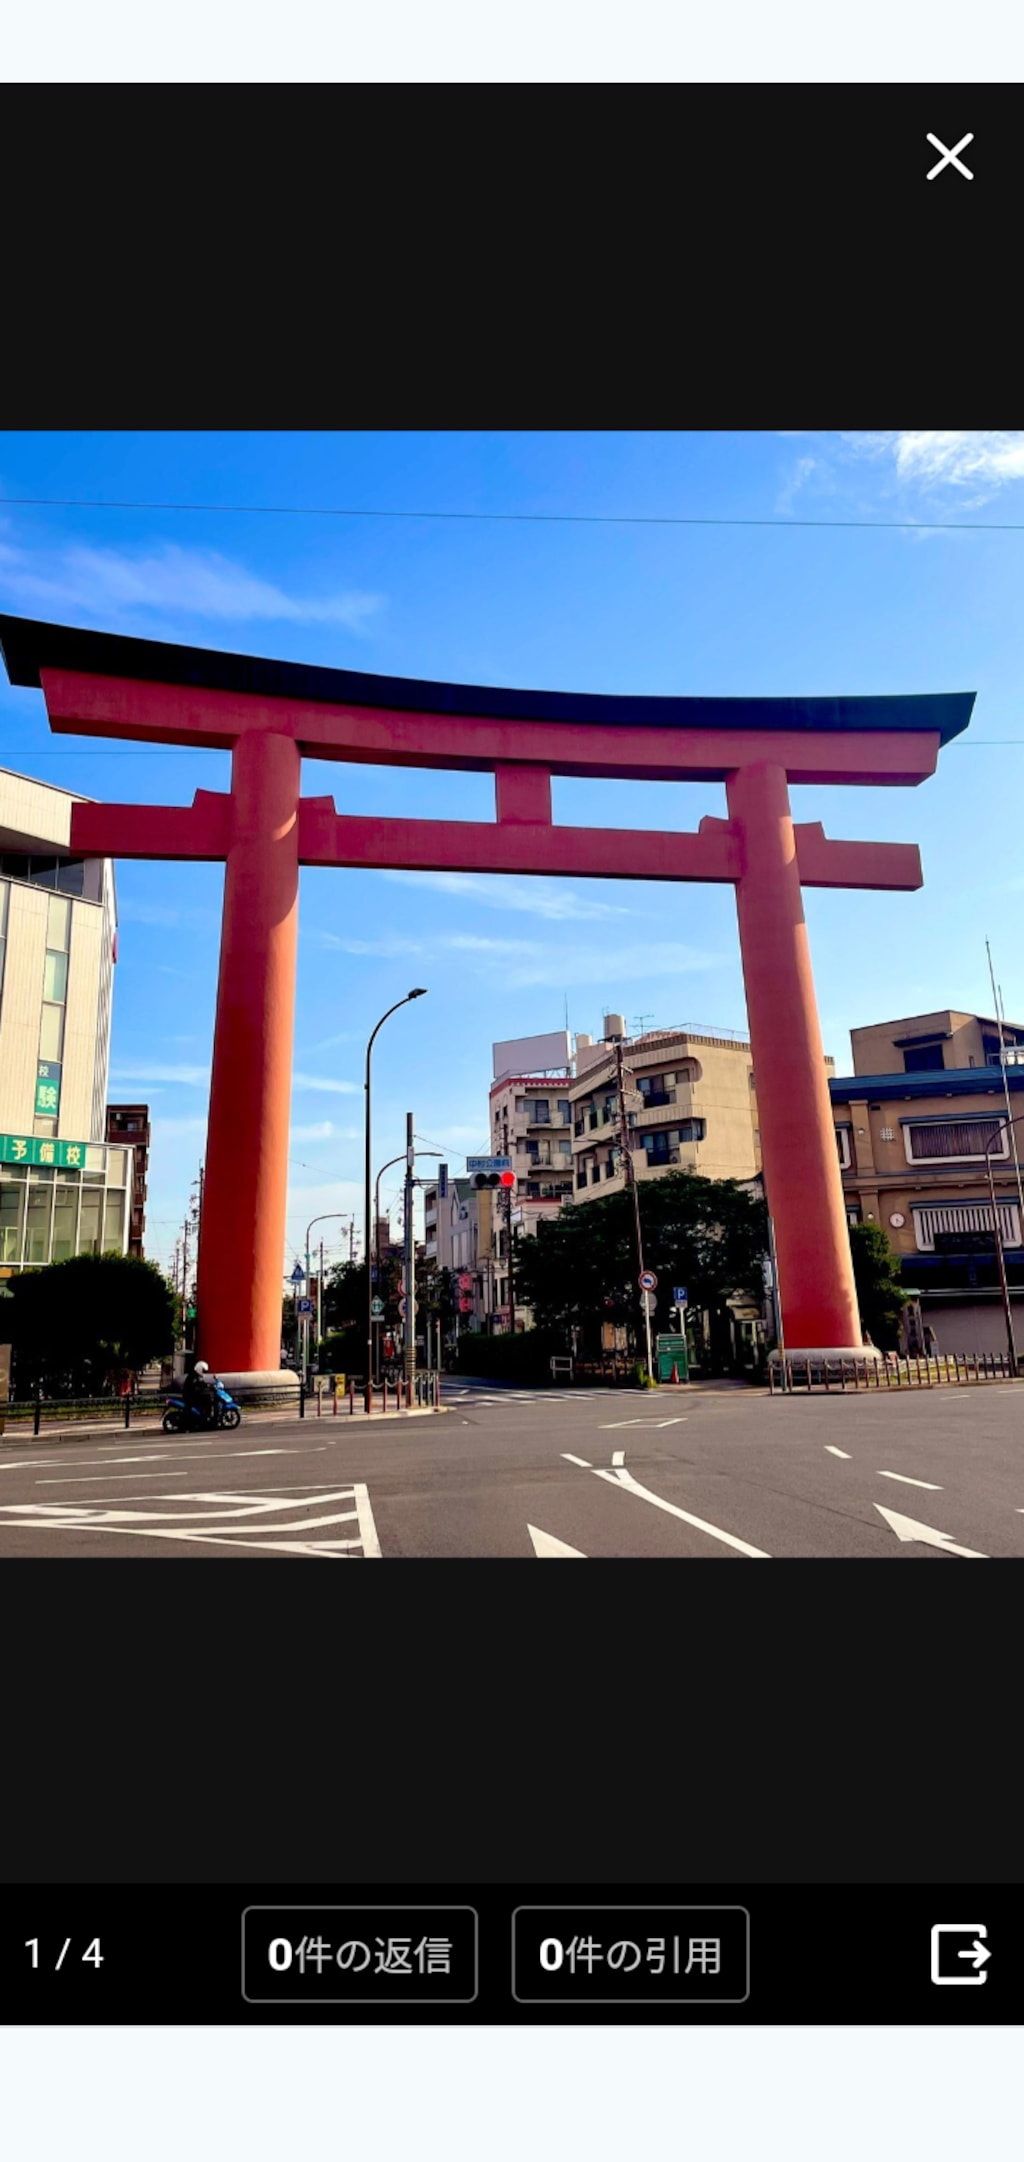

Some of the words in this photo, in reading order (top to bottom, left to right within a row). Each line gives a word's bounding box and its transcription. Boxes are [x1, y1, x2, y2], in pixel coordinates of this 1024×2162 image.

[38, 1065, 49, 1077] 校
[38, 1085, 57, 1109] 験
[11, 1139, 81, 1166] 予備校
